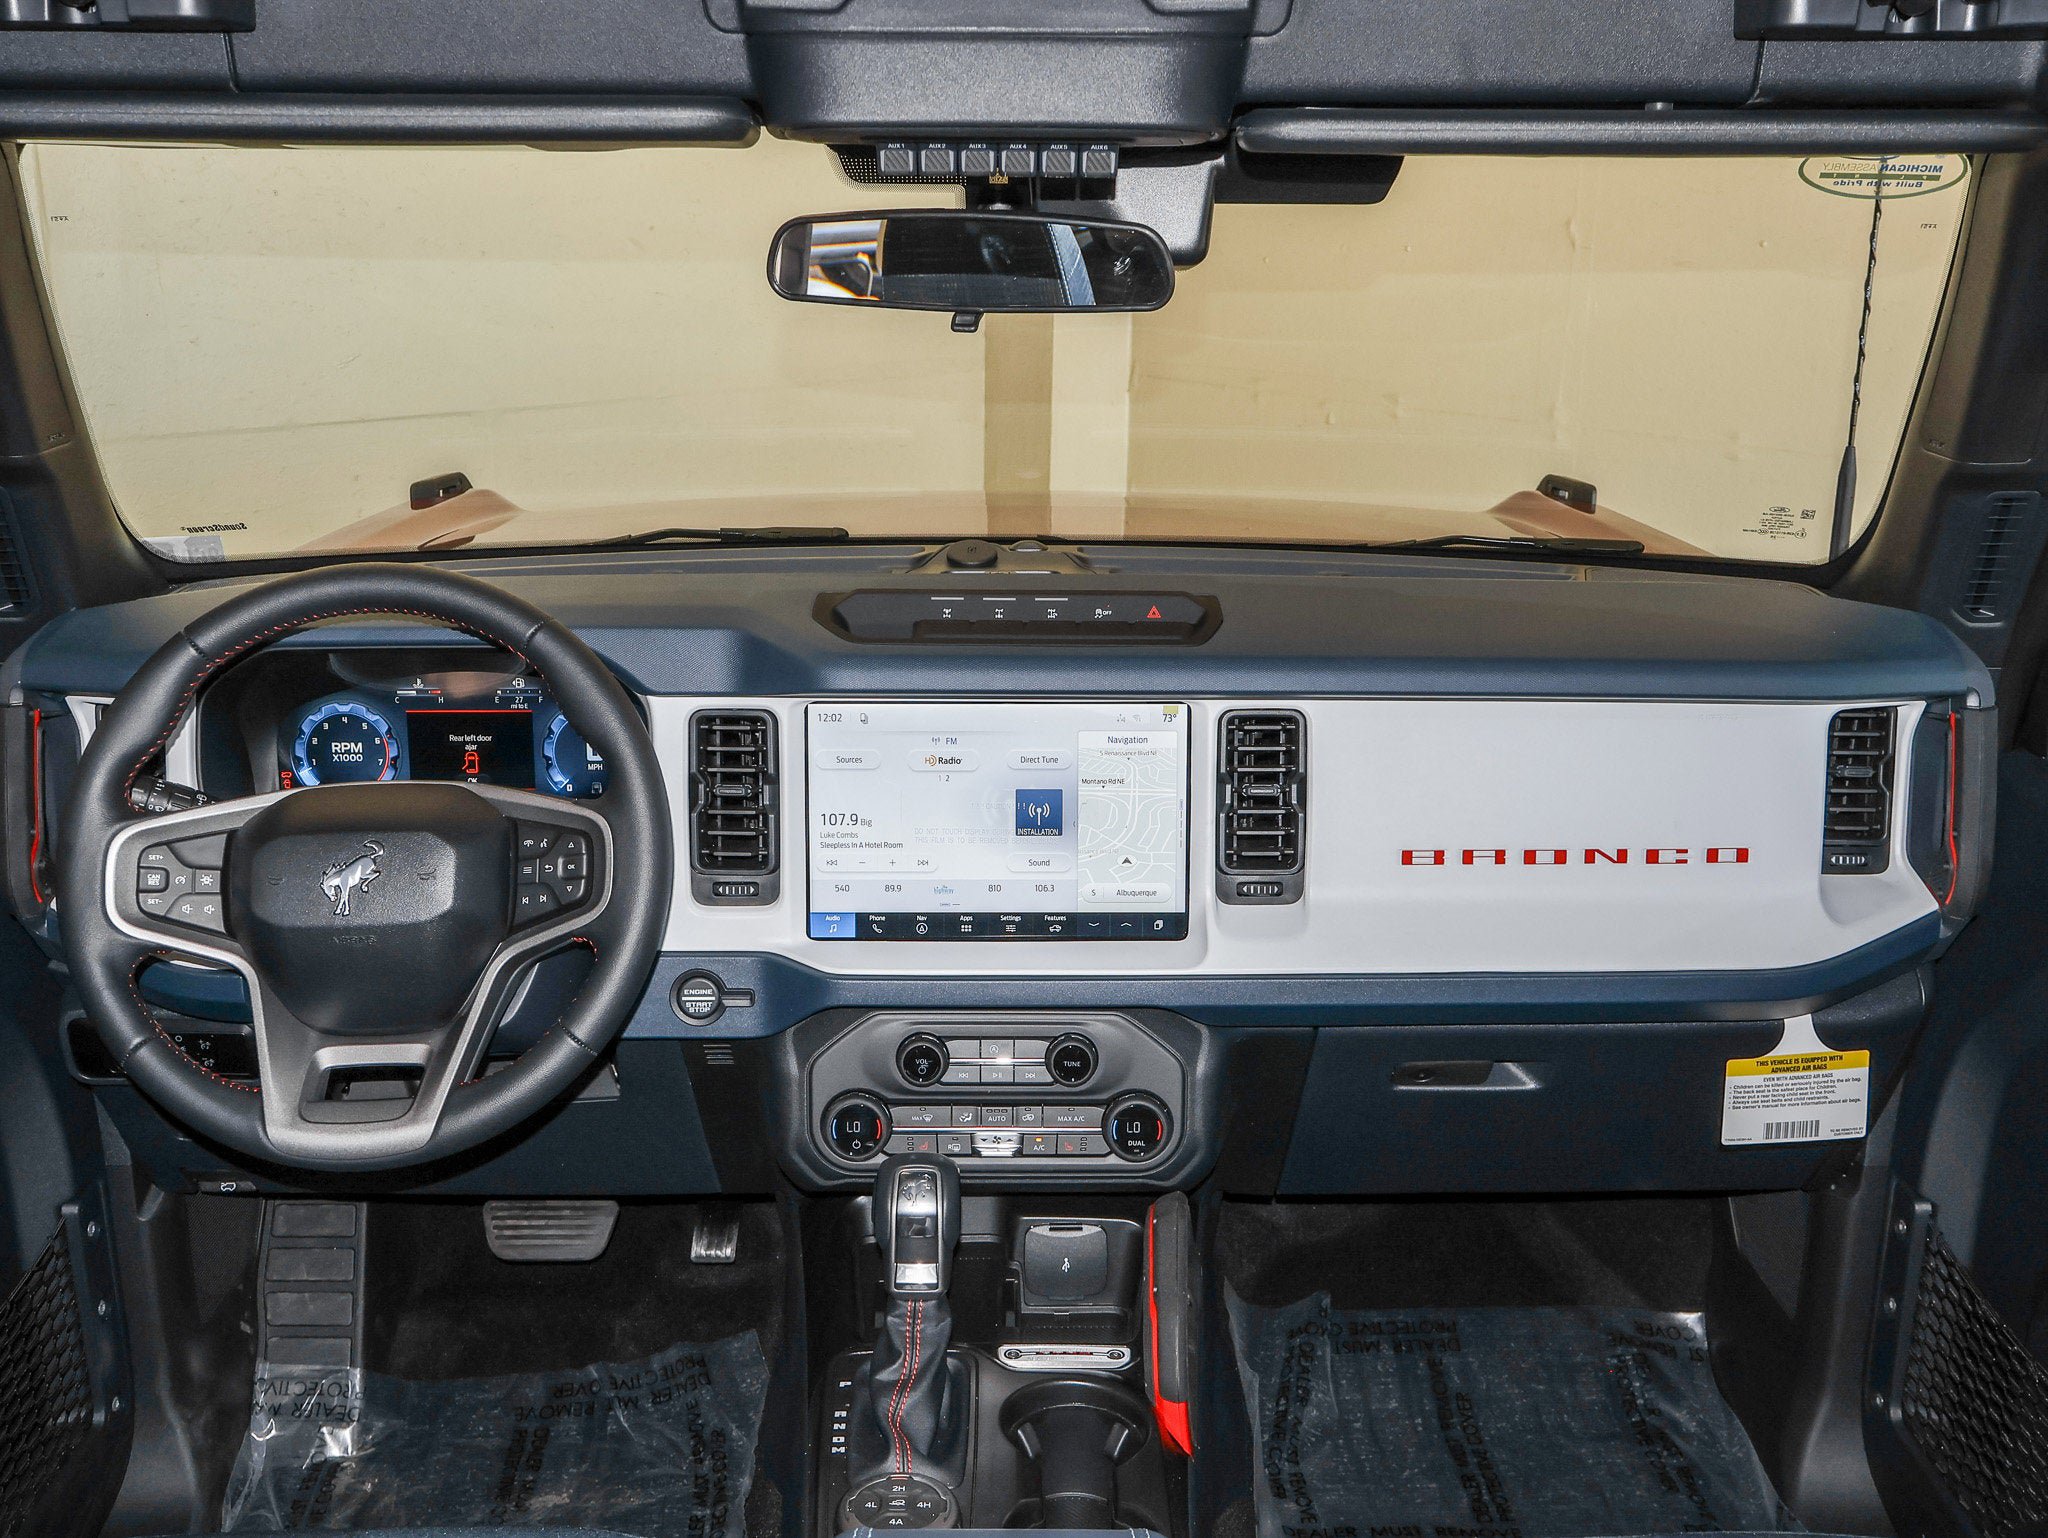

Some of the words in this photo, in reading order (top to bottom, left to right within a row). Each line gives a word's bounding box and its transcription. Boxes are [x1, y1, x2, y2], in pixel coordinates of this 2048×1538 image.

[818, 713, 842, 722] 12:02
[1163, 714, 1176, 723] 73°
[1108, 736, 1148, 745] Navigation
[331, 742, 363, 753] RPM
[332, 754, 363, 762] X1000
[836, 756, 862, 764] Sources
[938, 757, 962, 765] Radio
[566, 784, 573, 792] 0
[820, 813, 858, 826] 107.9
[860, 818, 872, 827] Big
[1017, 828, 1059, 836] INSTALLATION
[1400, 848, 1750, 866] BRONCO
[835, 884, 850, 892] 540
[885, 884, 902, 892] 89.9
[1116, 889, 1157, 897] Albuquerque
